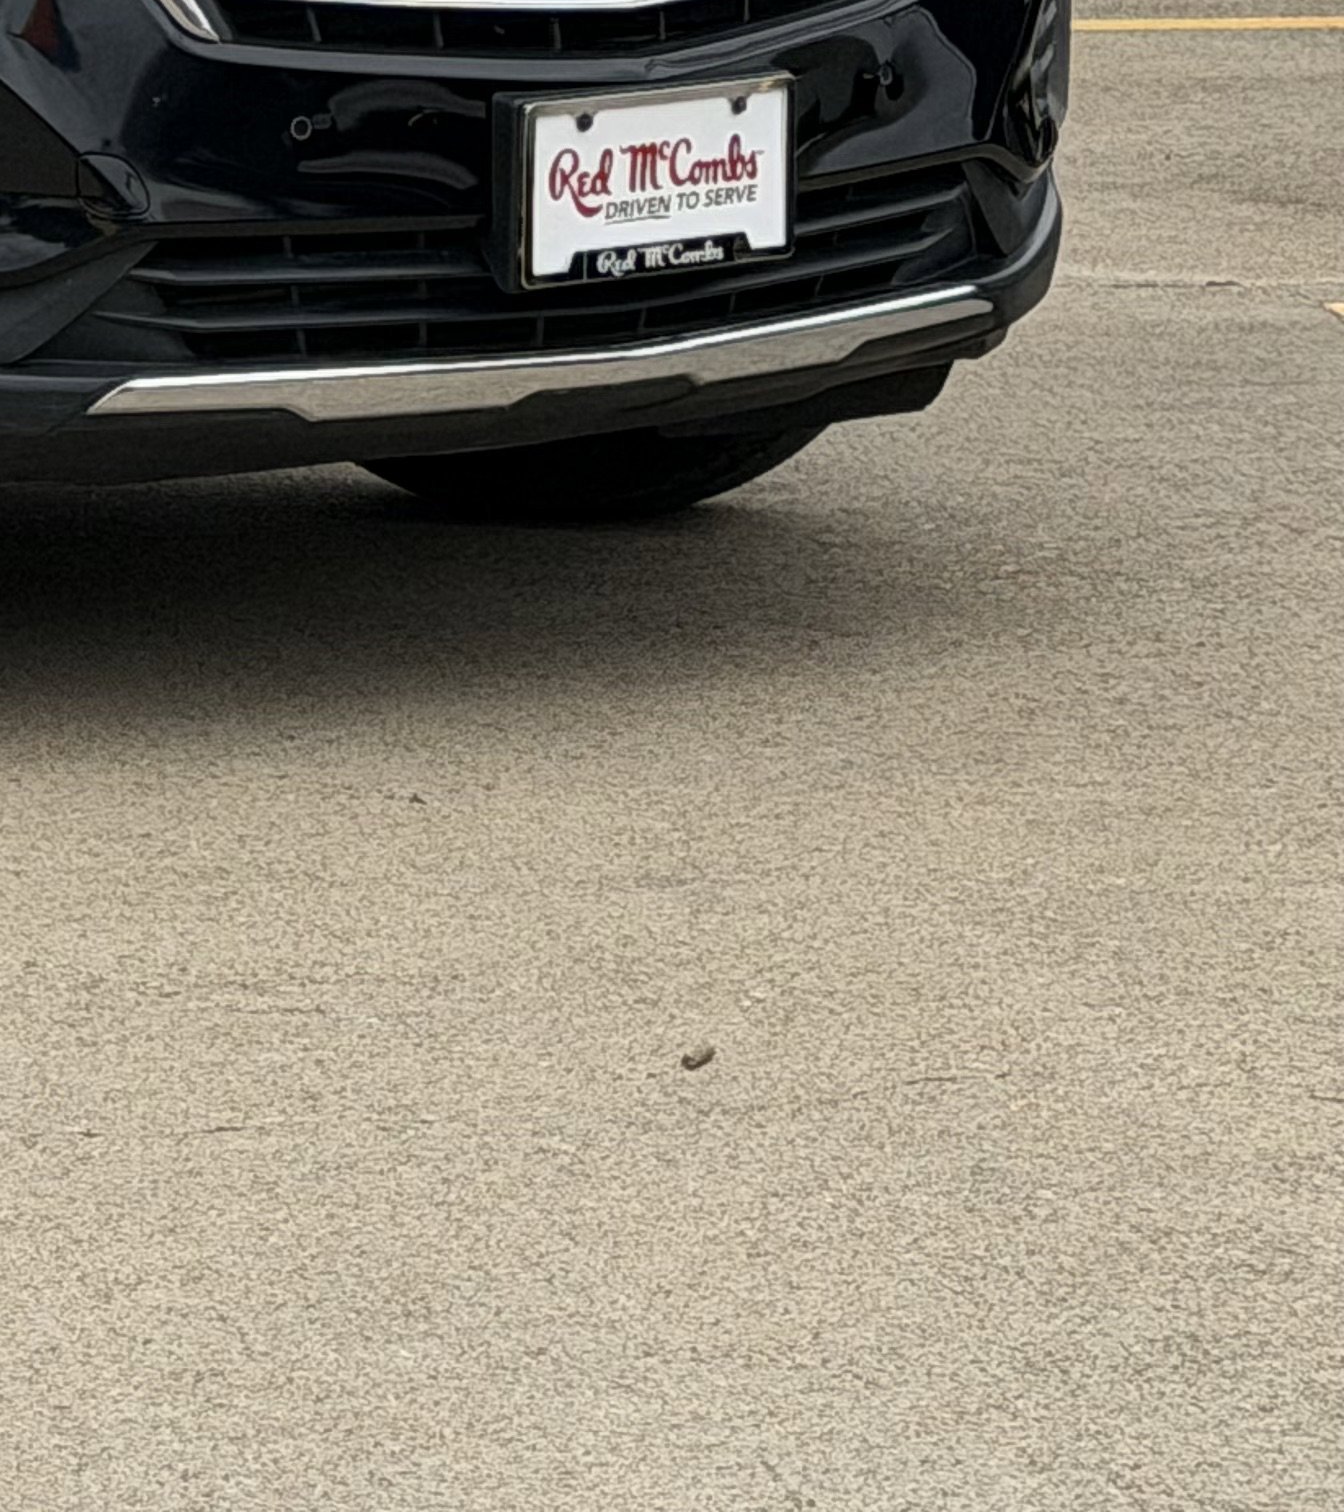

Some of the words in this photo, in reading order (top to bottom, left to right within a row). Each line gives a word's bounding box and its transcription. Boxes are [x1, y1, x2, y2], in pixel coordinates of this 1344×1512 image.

[548, 148, 612, 218] Red
[619, 134, 759, 194] McCombs
[605, 195, 671, 221] DRIVEN
[677, 191, 700, 211] TO
[704, 184, 759, 208] SERVE
[597, 249, 635, 277] Red
[637, 240, 724, 268] McCombs
